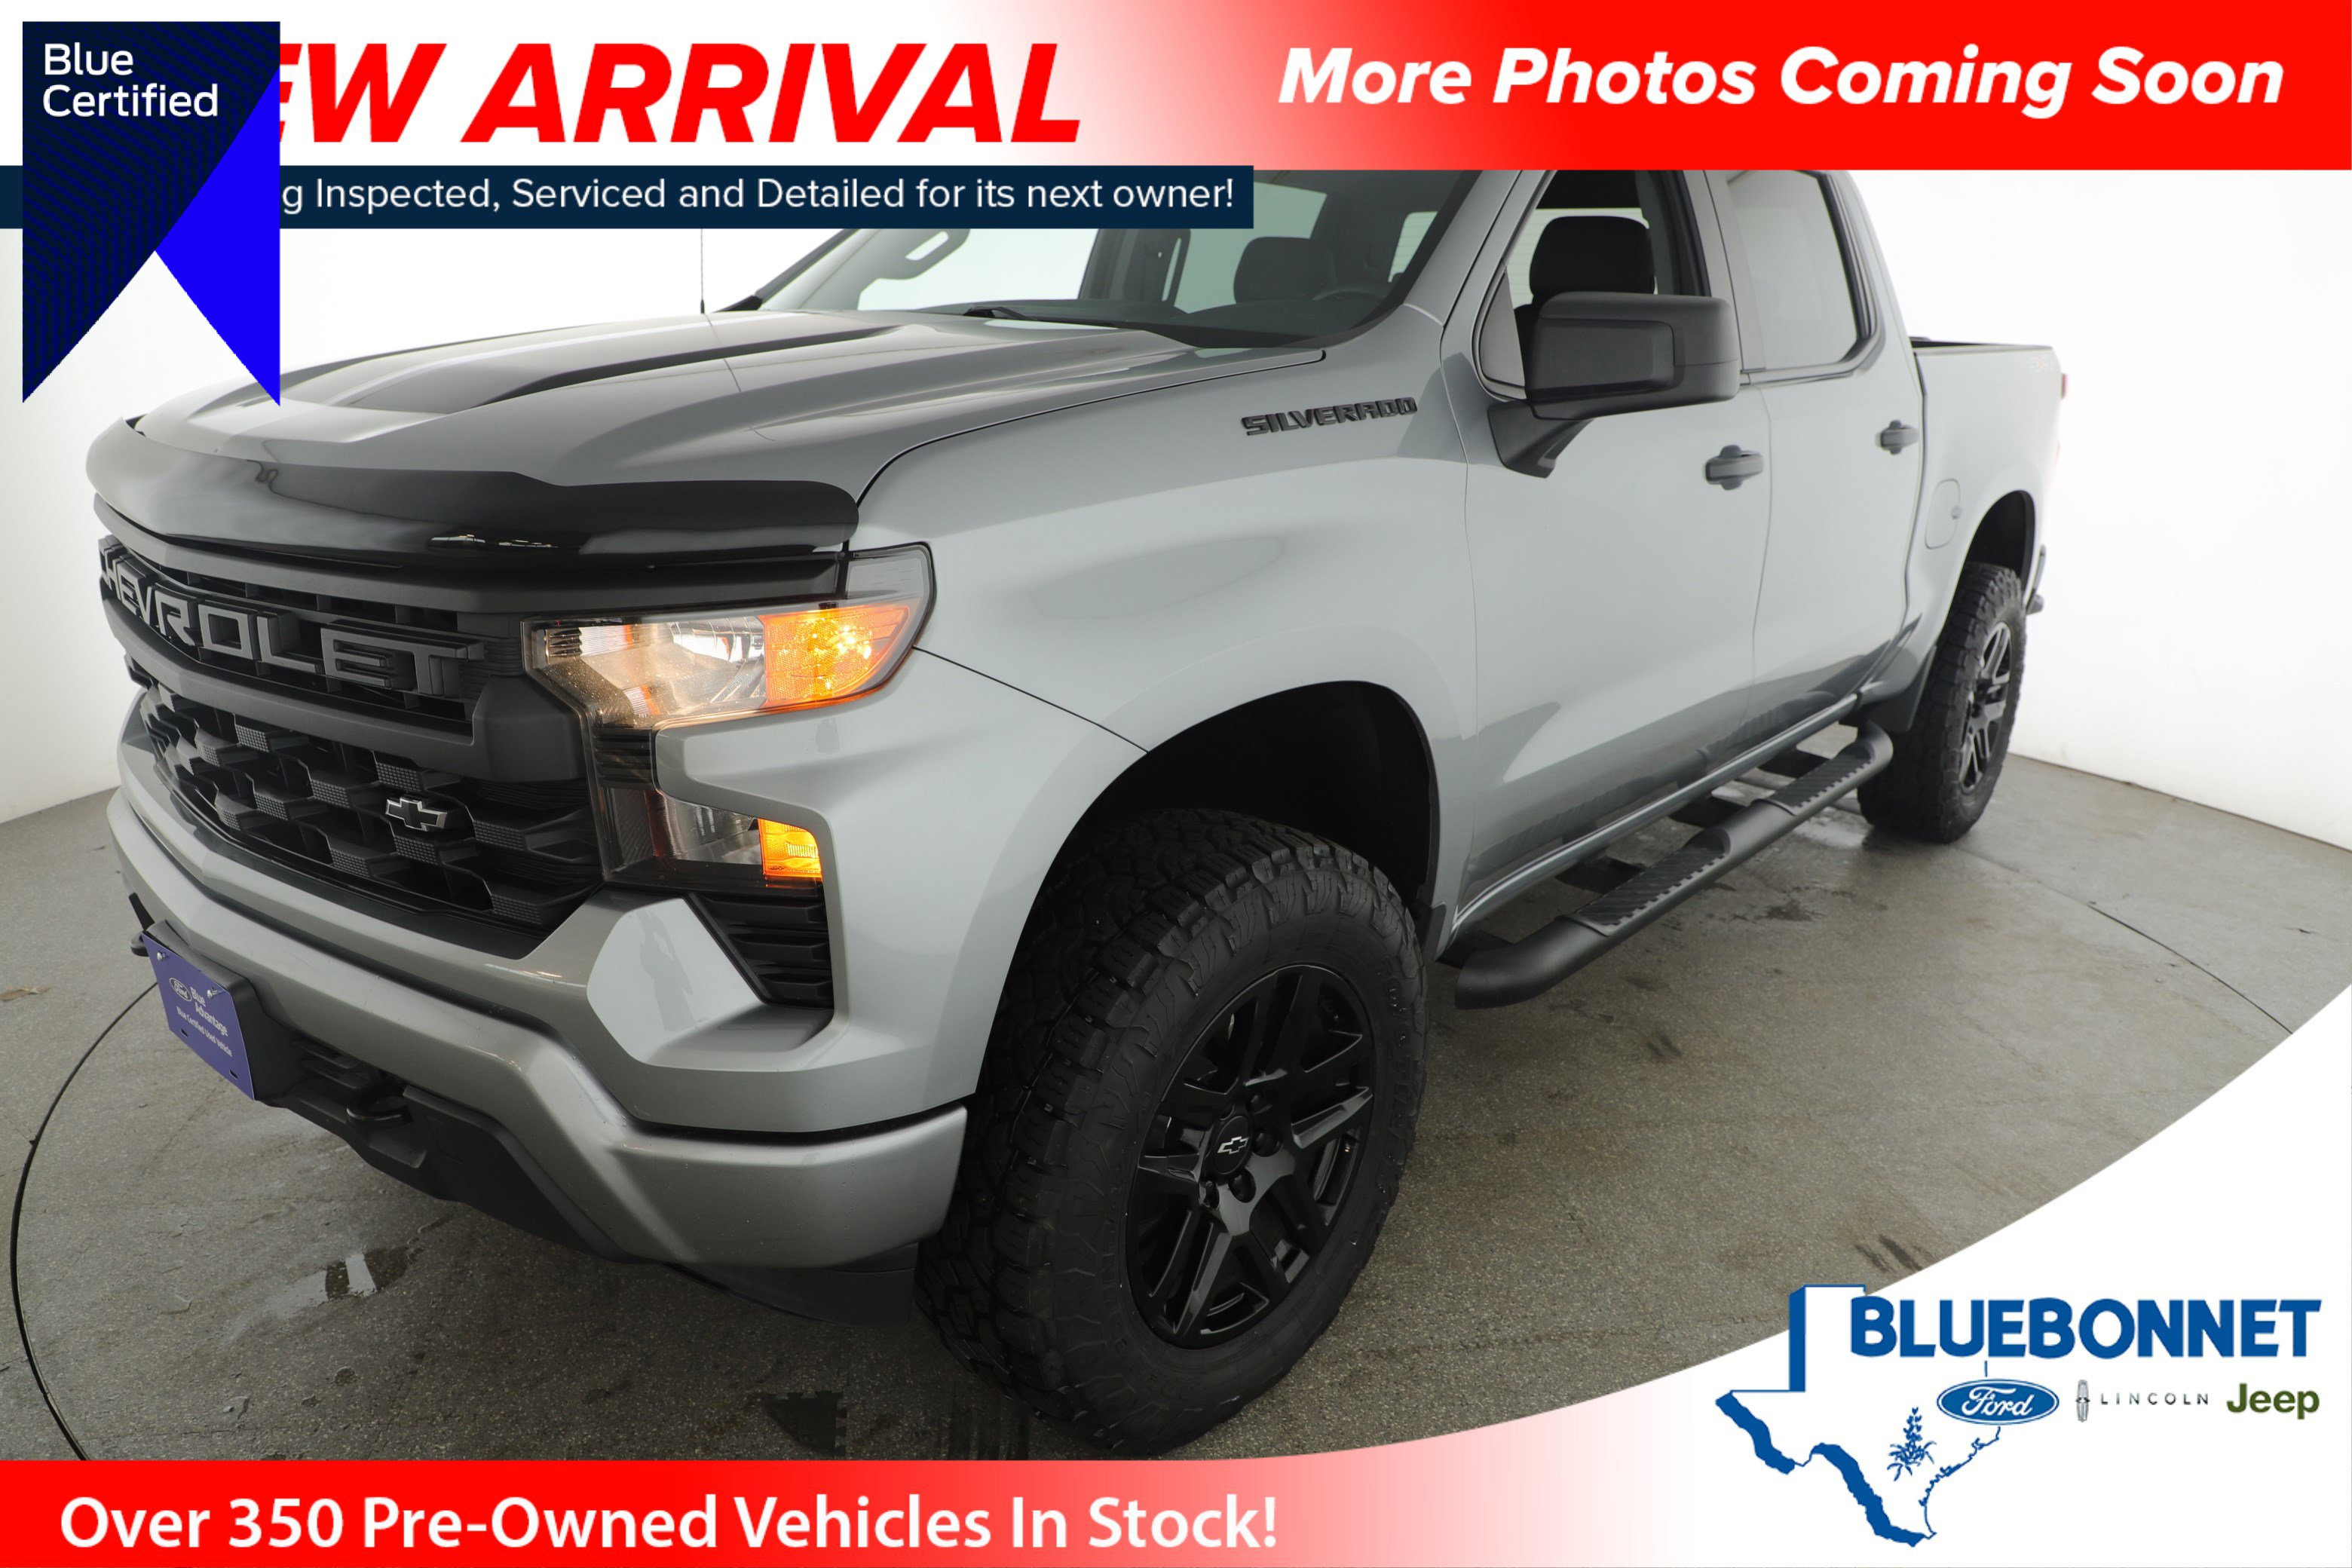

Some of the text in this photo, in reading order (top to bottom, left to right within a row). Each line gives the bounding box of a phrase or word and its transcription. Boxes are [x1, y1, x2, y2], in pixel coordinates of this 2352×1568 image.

[1242, 397, 1417, 436] SILVERADO
[190, 987, 206, 1007] Blue
[195, 1002, 228, 1037] Advantage
